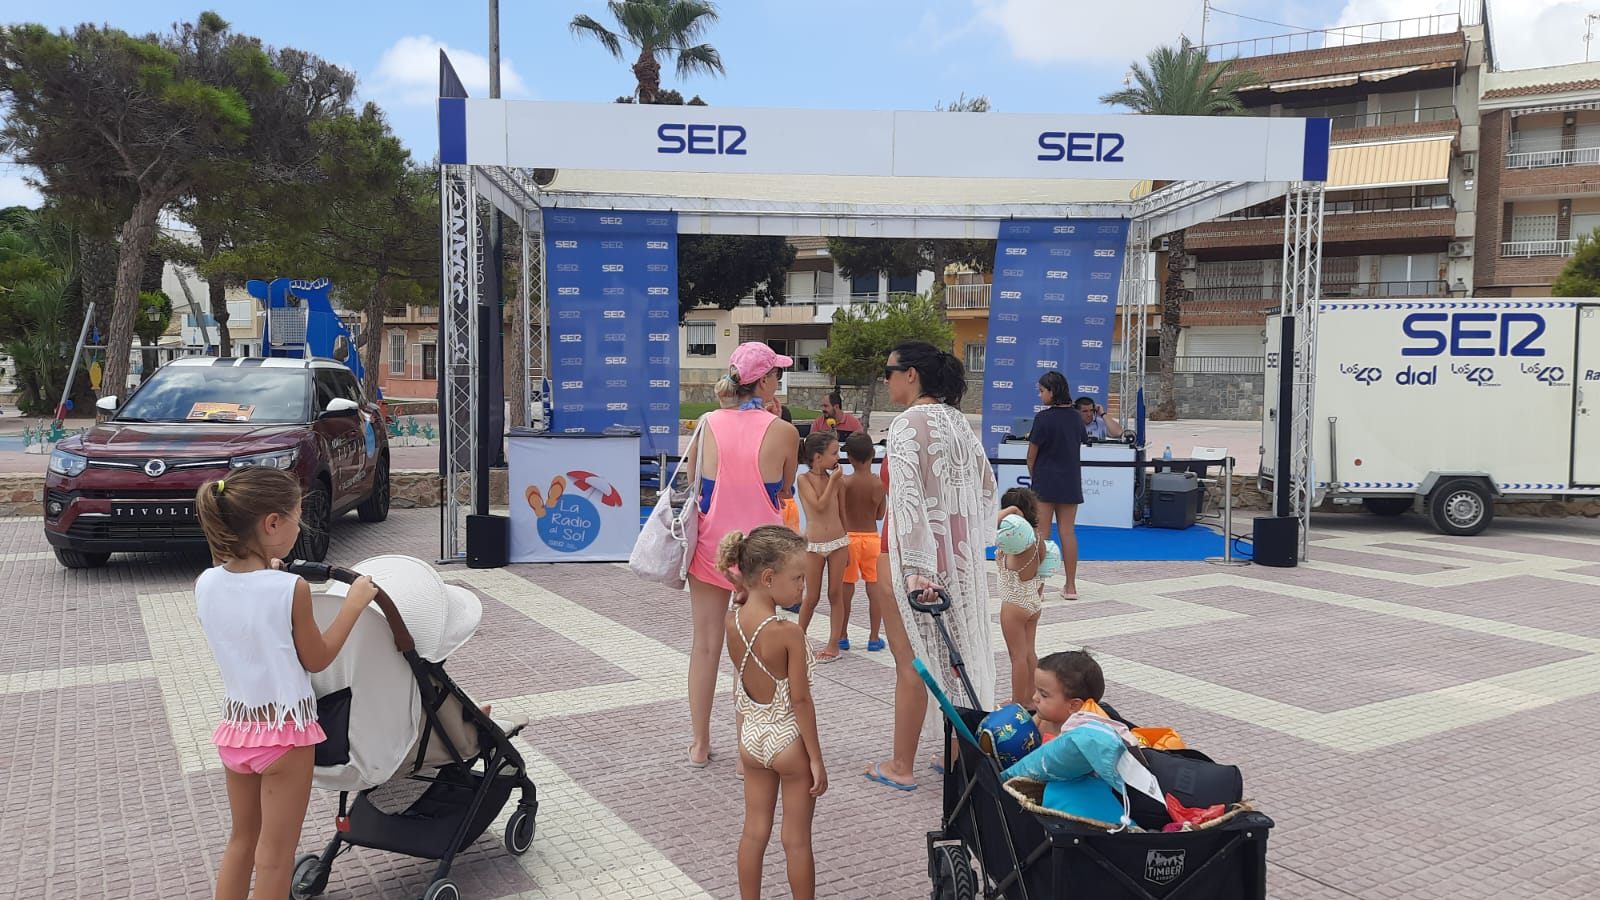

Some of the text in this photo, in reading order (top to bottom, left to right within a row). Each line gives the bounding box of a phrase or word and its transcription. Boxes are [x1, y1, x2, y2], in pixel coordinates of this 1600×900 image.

[657, 123, 748, 156] SER
[1037, 131, 1125, 163] SER
[600, 216, 622, 224] SER
[1052, 226, 1076, 234] SER
[554, 240, 578, 248] SER
[646, 242, 668, 250] SER
[1006, 248, 1028, 256] SER
[1094, 250, 1116, 258] SER
[602, 264, 624, 272] SER
[1046, 270, 1068, 278] SER
[558, 286, 580, 296] SER
[648, 286, 670, 296] SER
[1000, 290, 1022, 300] SER
[1086, 294, 1108, 302] SER
[604, 310, 626, 318] SER
[1040, 316, 1062, 324] SER
[560, 334, 582, 342] SER
[648, 334, 670, 342] SER
[1401, 312, 1546, 357] SER
[996, 336, 1018, 344] SER
[1082, 340, 1102, 348] SER
[604, 356, 628, 364] SER
[1036, 360, 1058, 368] SER
[1395, 364, 1437, 385] dial
[562, 380, 584, 390] SER
[650, 380, 670, 388] SER
[992, 380, 1014, 388] SER
[1078, 384, 1100, 394] SER
[606, 402, 628, 410] SER
[648, 426, 670, 434] SER
[990, 426, 1012, 434] SER
[560, 499, 579, 512] La
[115, 507, 189, 516] TIVOLI
[551, 513, 591, 528] Radio
[563, 528, 585, 542] Sol
[1148, 864, 1182, 878] TIMBER
